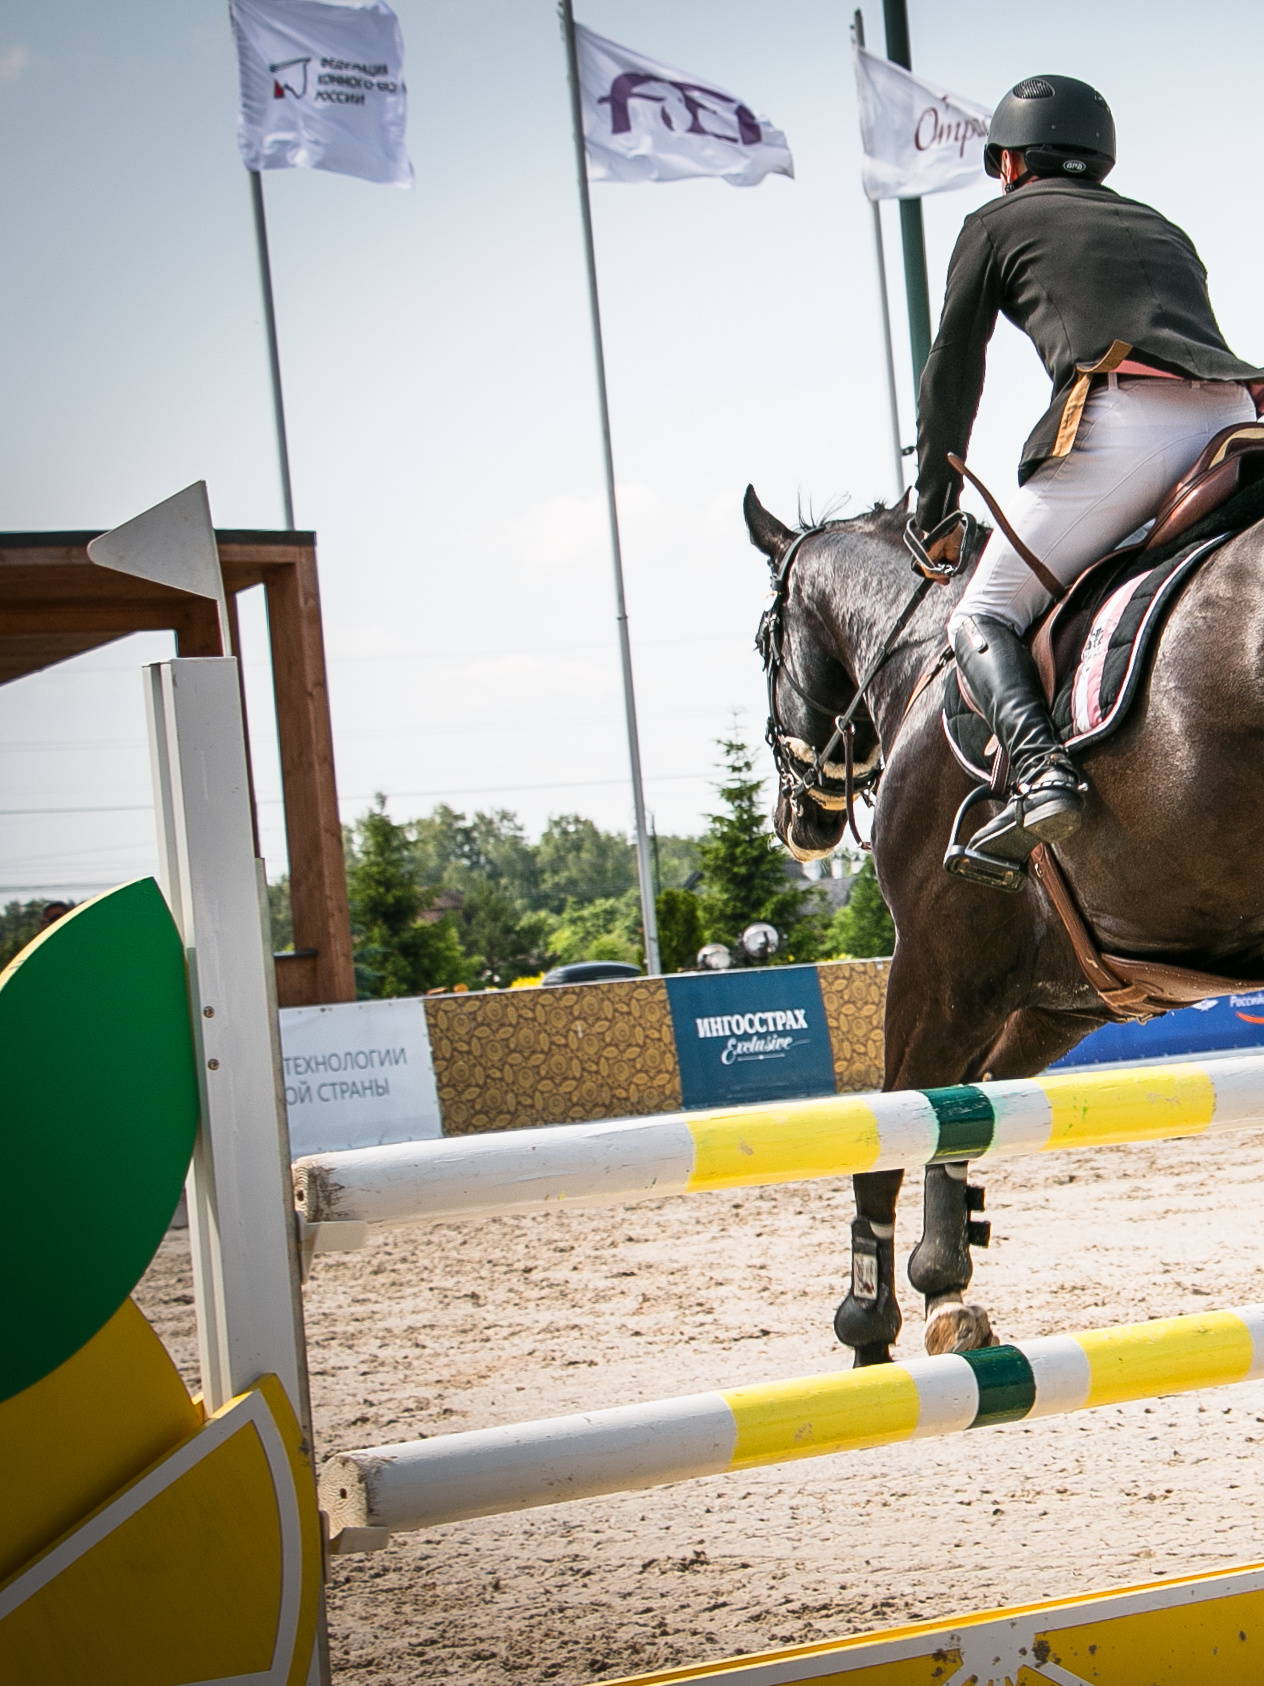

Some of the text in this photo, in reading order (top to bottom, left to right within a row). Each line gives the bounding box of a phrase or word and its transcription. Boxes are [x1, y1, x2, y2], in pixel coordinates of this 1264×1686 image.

[695, 1008, 809, 1039] ИНГОССТРАХ
[283, 1047, 407, 1076] ТЕХНОЛОГИИ
[721, 1034, 795, 1066] Exclusive
[317, 1077, 390, 1103] СТРАНЫ
